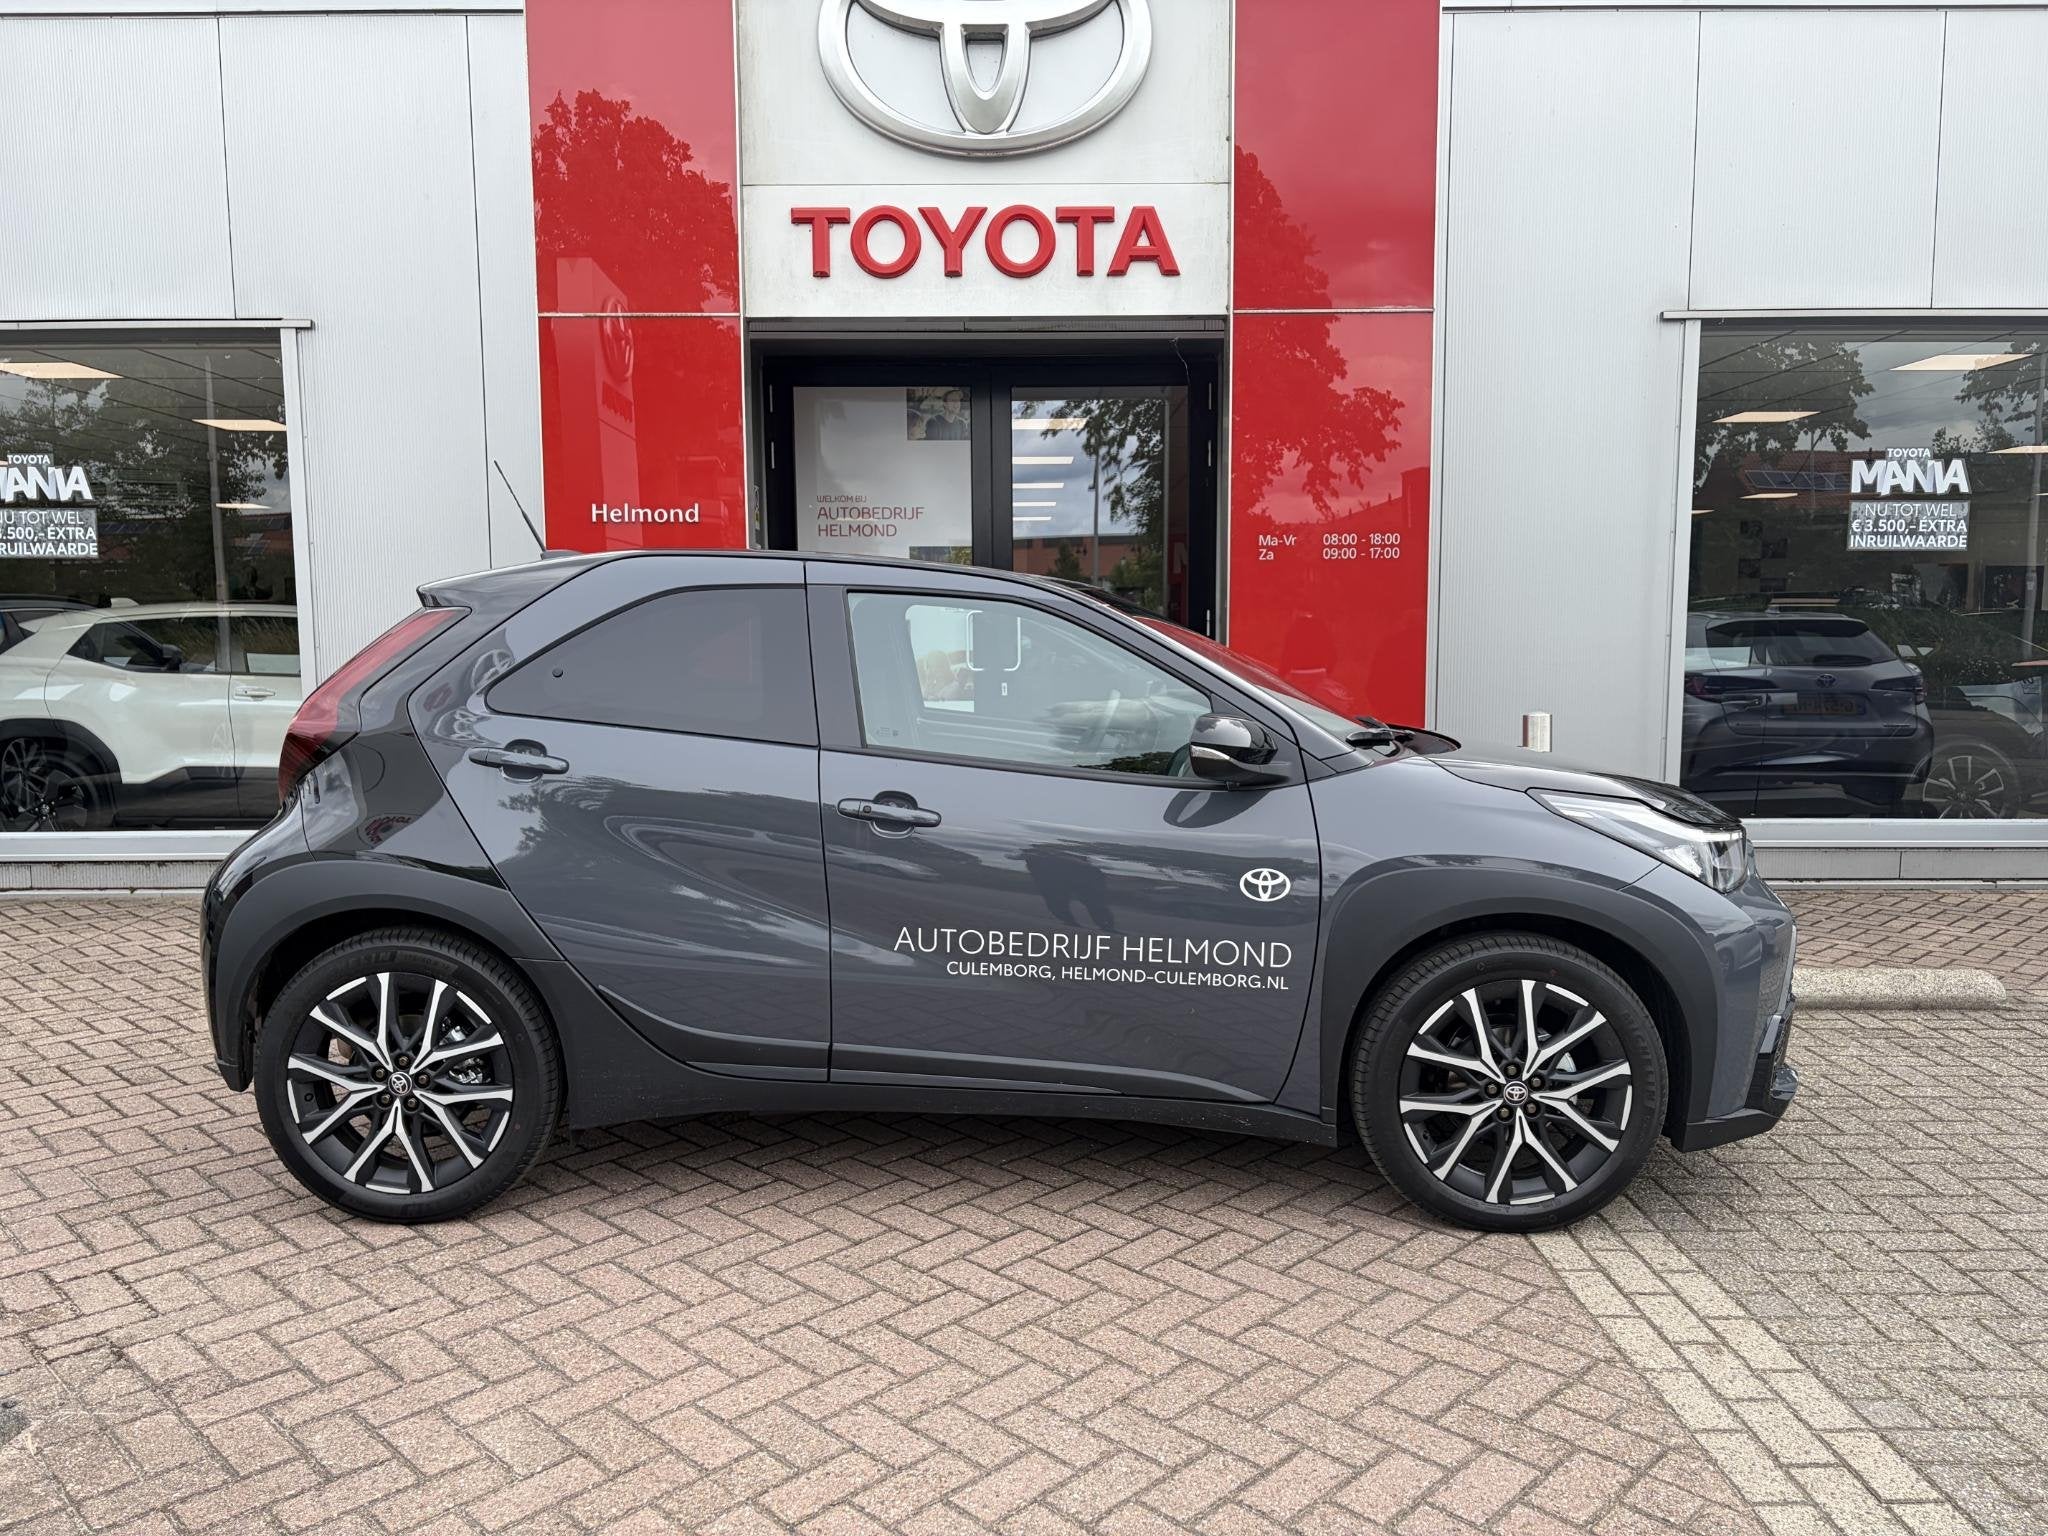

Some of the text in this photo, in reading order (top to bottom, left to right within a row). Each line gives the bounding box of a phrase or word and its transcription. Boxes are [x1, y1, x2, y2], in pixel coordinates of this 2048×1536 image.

[791, 205, 1181, 279] TOYOTA
[7, 454, 51, 465] TOYOTA
[1887, 448, 1931, 458] TOYOTA
[0, 466, 93, 502] ANIA
[1851, 459, 1969, 496] MANIA
[816, 495, 854, 503] WELKOM
[591, 502, 700, 523] Helmond
[817, 506, 925, 520] AUTOBEDRIJF
[1865, 503, 1957, 517] NU TOT WEL
[19, 511, 47, 524] TOT
[51, 511, 84, 525] WEL
[1919, 516, 1968, 532] ÉXTRA
[0, 523, 97, 542] .500,- ÉXTRA
[818, 523, 897, 537] HELMOND
[1258, 534, 1297, 546] Ma-Vr
[1322, 534, 1358, 545] 08:00
[1369, 533, 1401, 545] 18:00
[1850, 534, 1968, 548] INRUILWAARDE
[1259, 549, 1275, 561] Za
[1322, 548, 1358, 560] 09:00
[1369, 548, 1401, 559] 17:00
[893, 926, 1293, 969] AUTOBEDRIJF HELMOND
[946, 961, 1290, 990] CULEMBORG, HELMOND-CULEMBORG.NL
